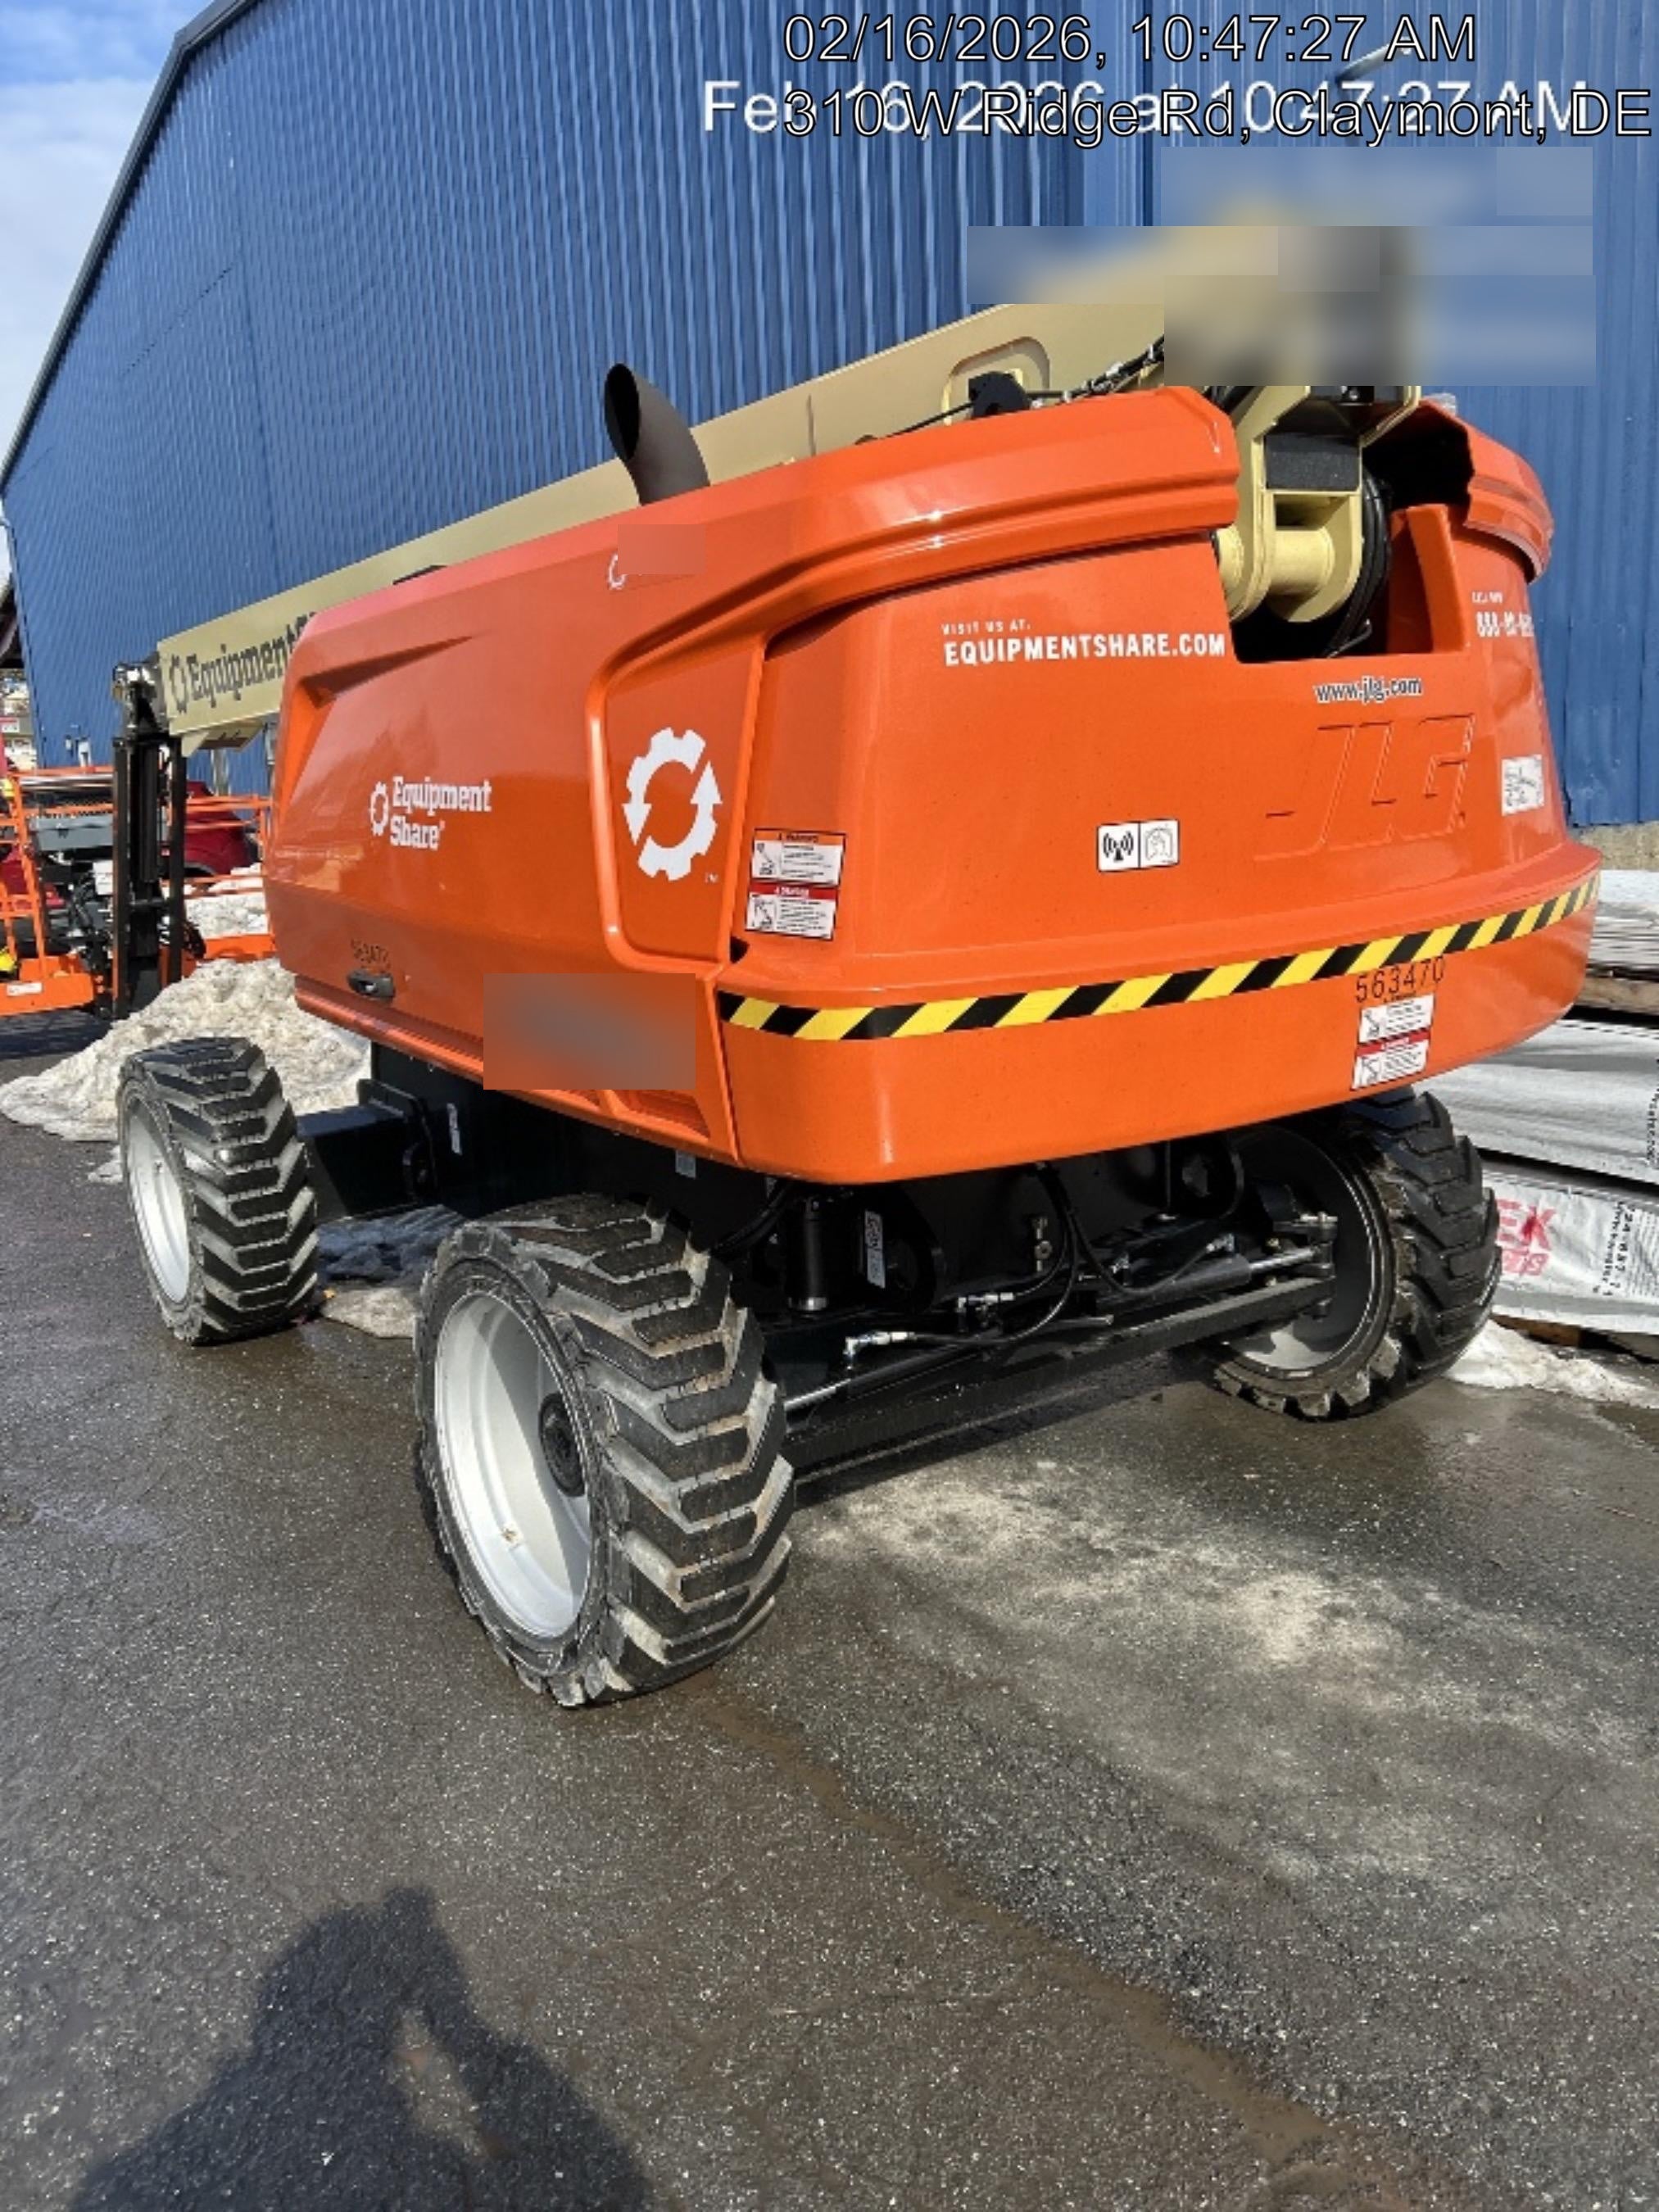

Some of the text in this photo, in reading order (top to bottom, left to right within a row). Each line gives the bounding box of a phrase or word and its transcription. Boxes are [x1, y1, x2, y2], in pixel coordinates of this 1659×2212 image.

[944, 632, 1226, 666] EQUIPMENTSHARE.COM
[1312, 675, 1423, 705] www.jlg.com
[392, 776, 492, 816] Equipment
[1356, 955, 1444, 1003] 563470
